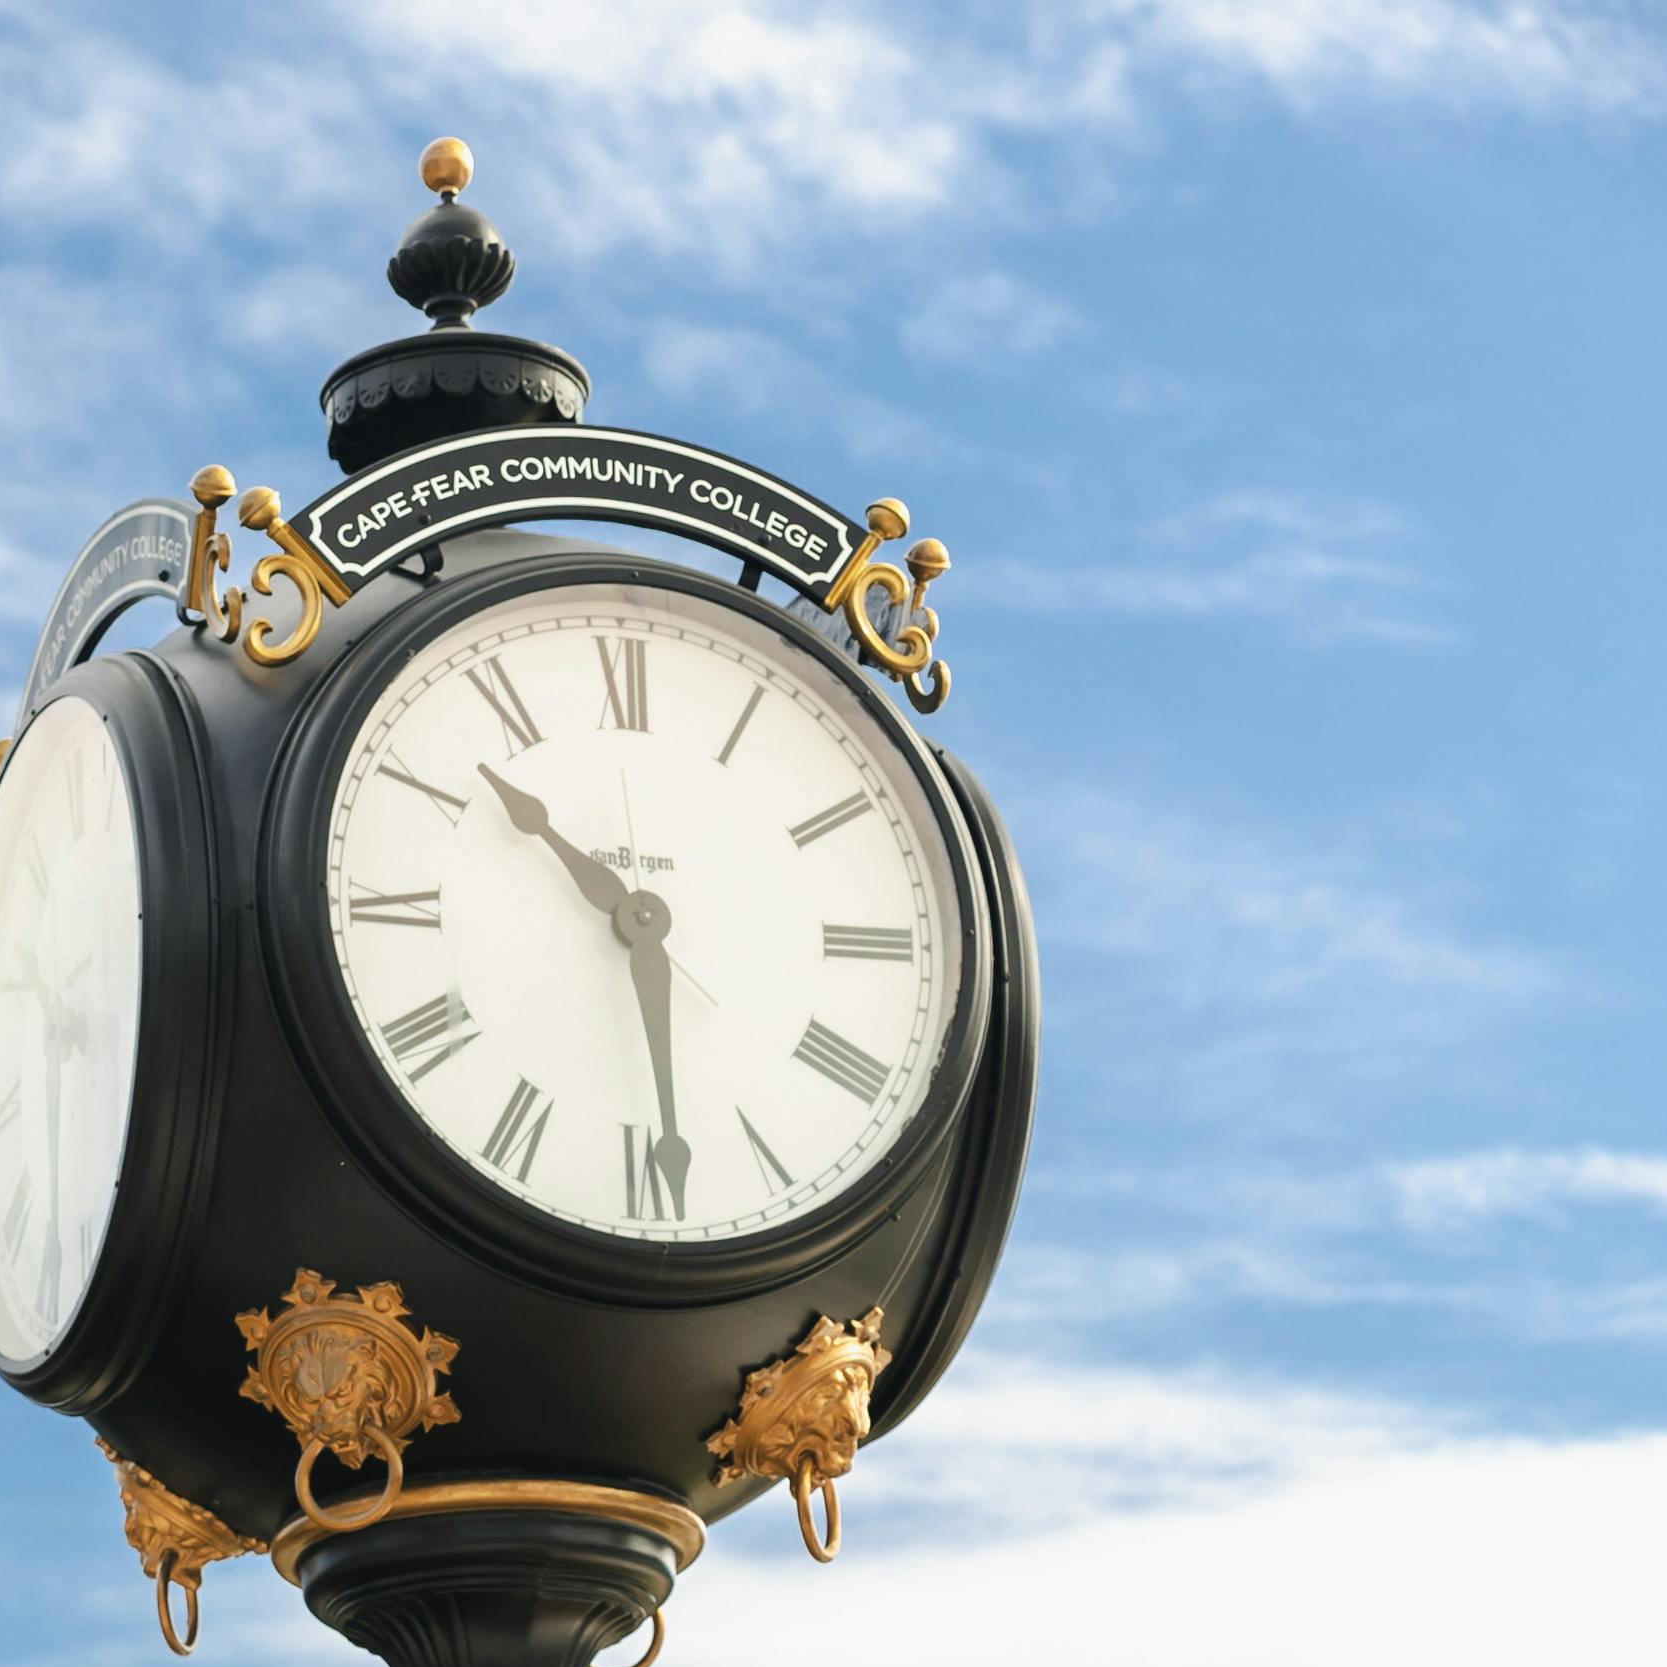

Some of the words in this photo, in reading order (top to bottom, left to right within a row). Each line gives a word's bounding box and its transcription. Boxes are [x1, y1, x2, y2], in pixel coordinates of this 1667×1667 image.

[500, 456, 684, 495] COMMUNITY
[689, 479, 828, 561] COLLEGE
[130, 535, 183, 568] COLLEGE
